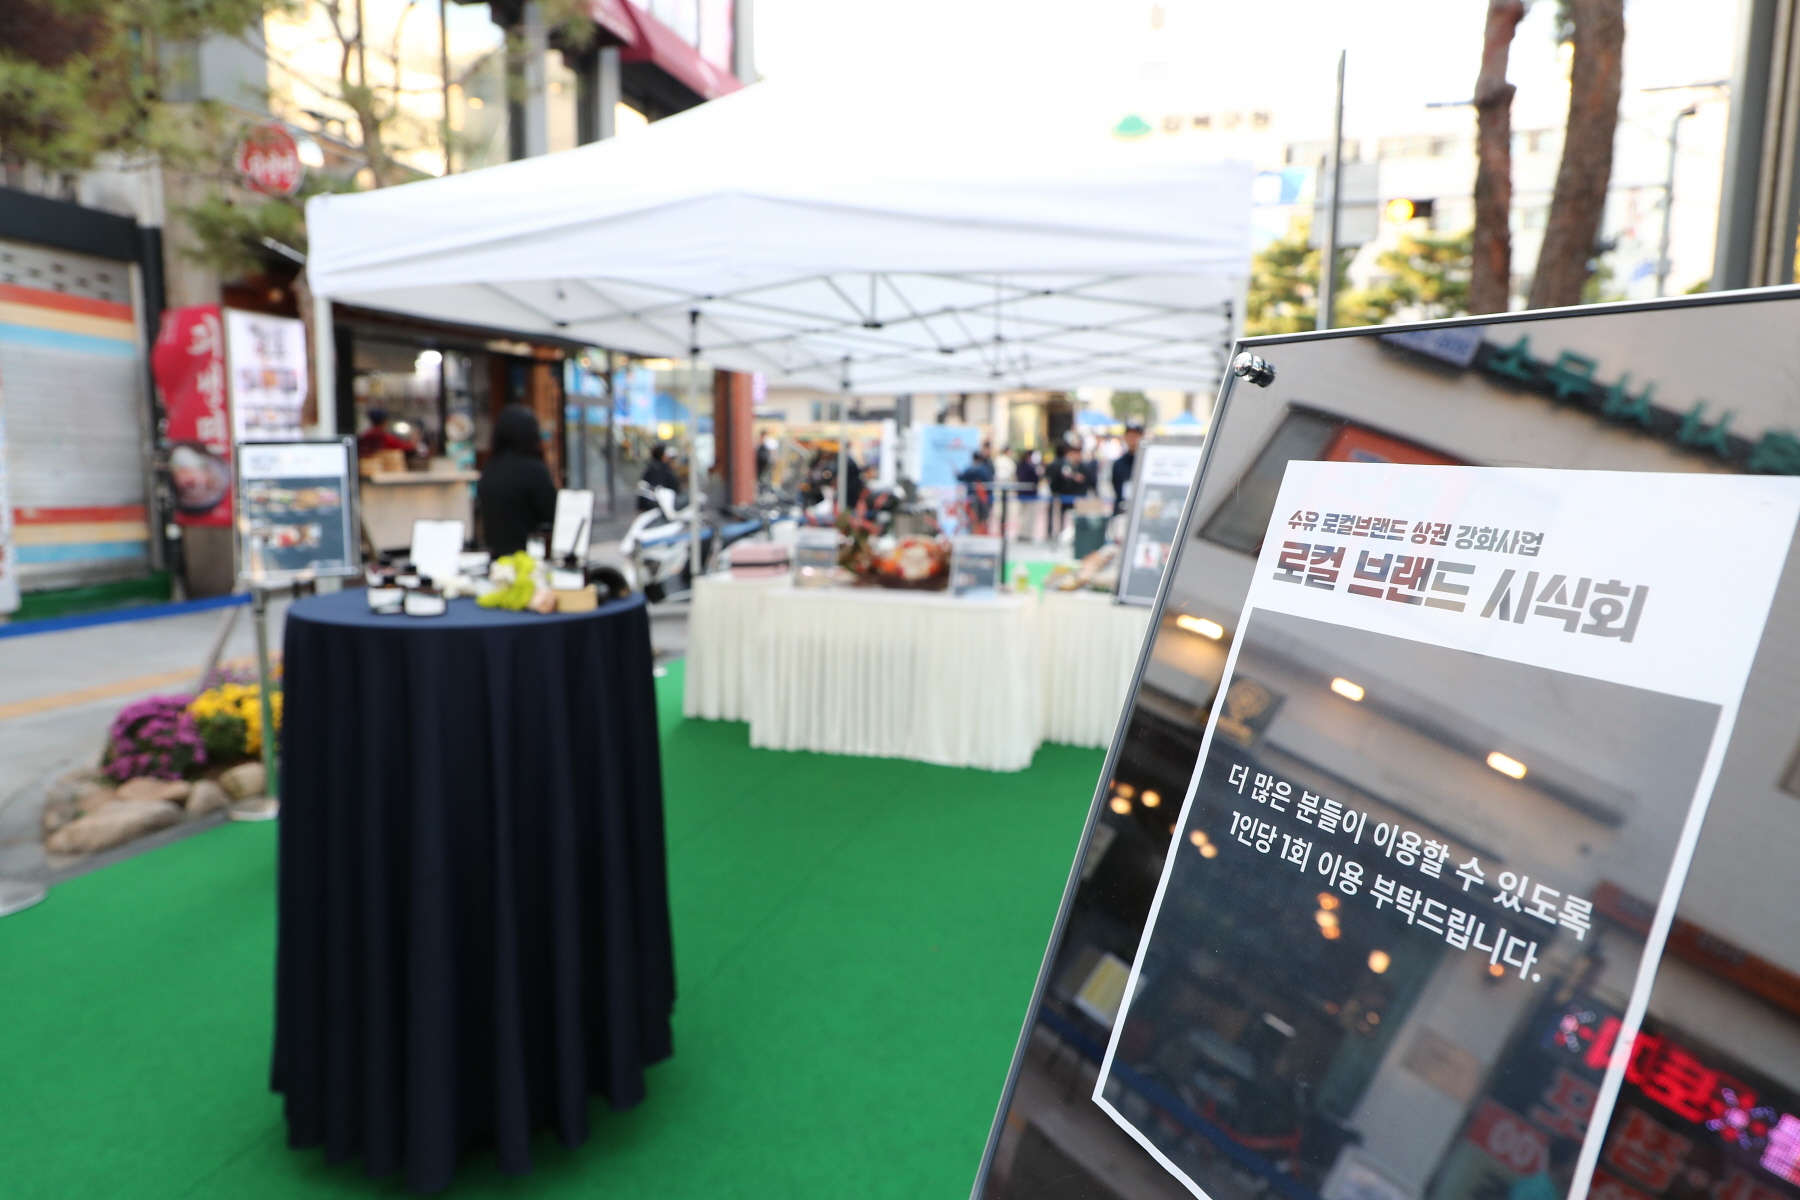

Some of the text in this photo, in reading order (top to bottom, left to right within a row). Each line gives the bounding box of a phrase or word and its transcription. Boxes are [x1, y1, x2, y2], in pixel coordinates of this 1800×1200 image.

[1272, 541, 1650, 644] 로컬 브랜드 시식회
[1287, 510, 1545, 557] 수유 로컬브랜드 상권 강화사업
[1228, 763, 1594, 941] 더 많은 분들이 이용할 수 있도록
[1229, 810, 1542, 983] 1인당 1회 이용 부탁드립니다.
